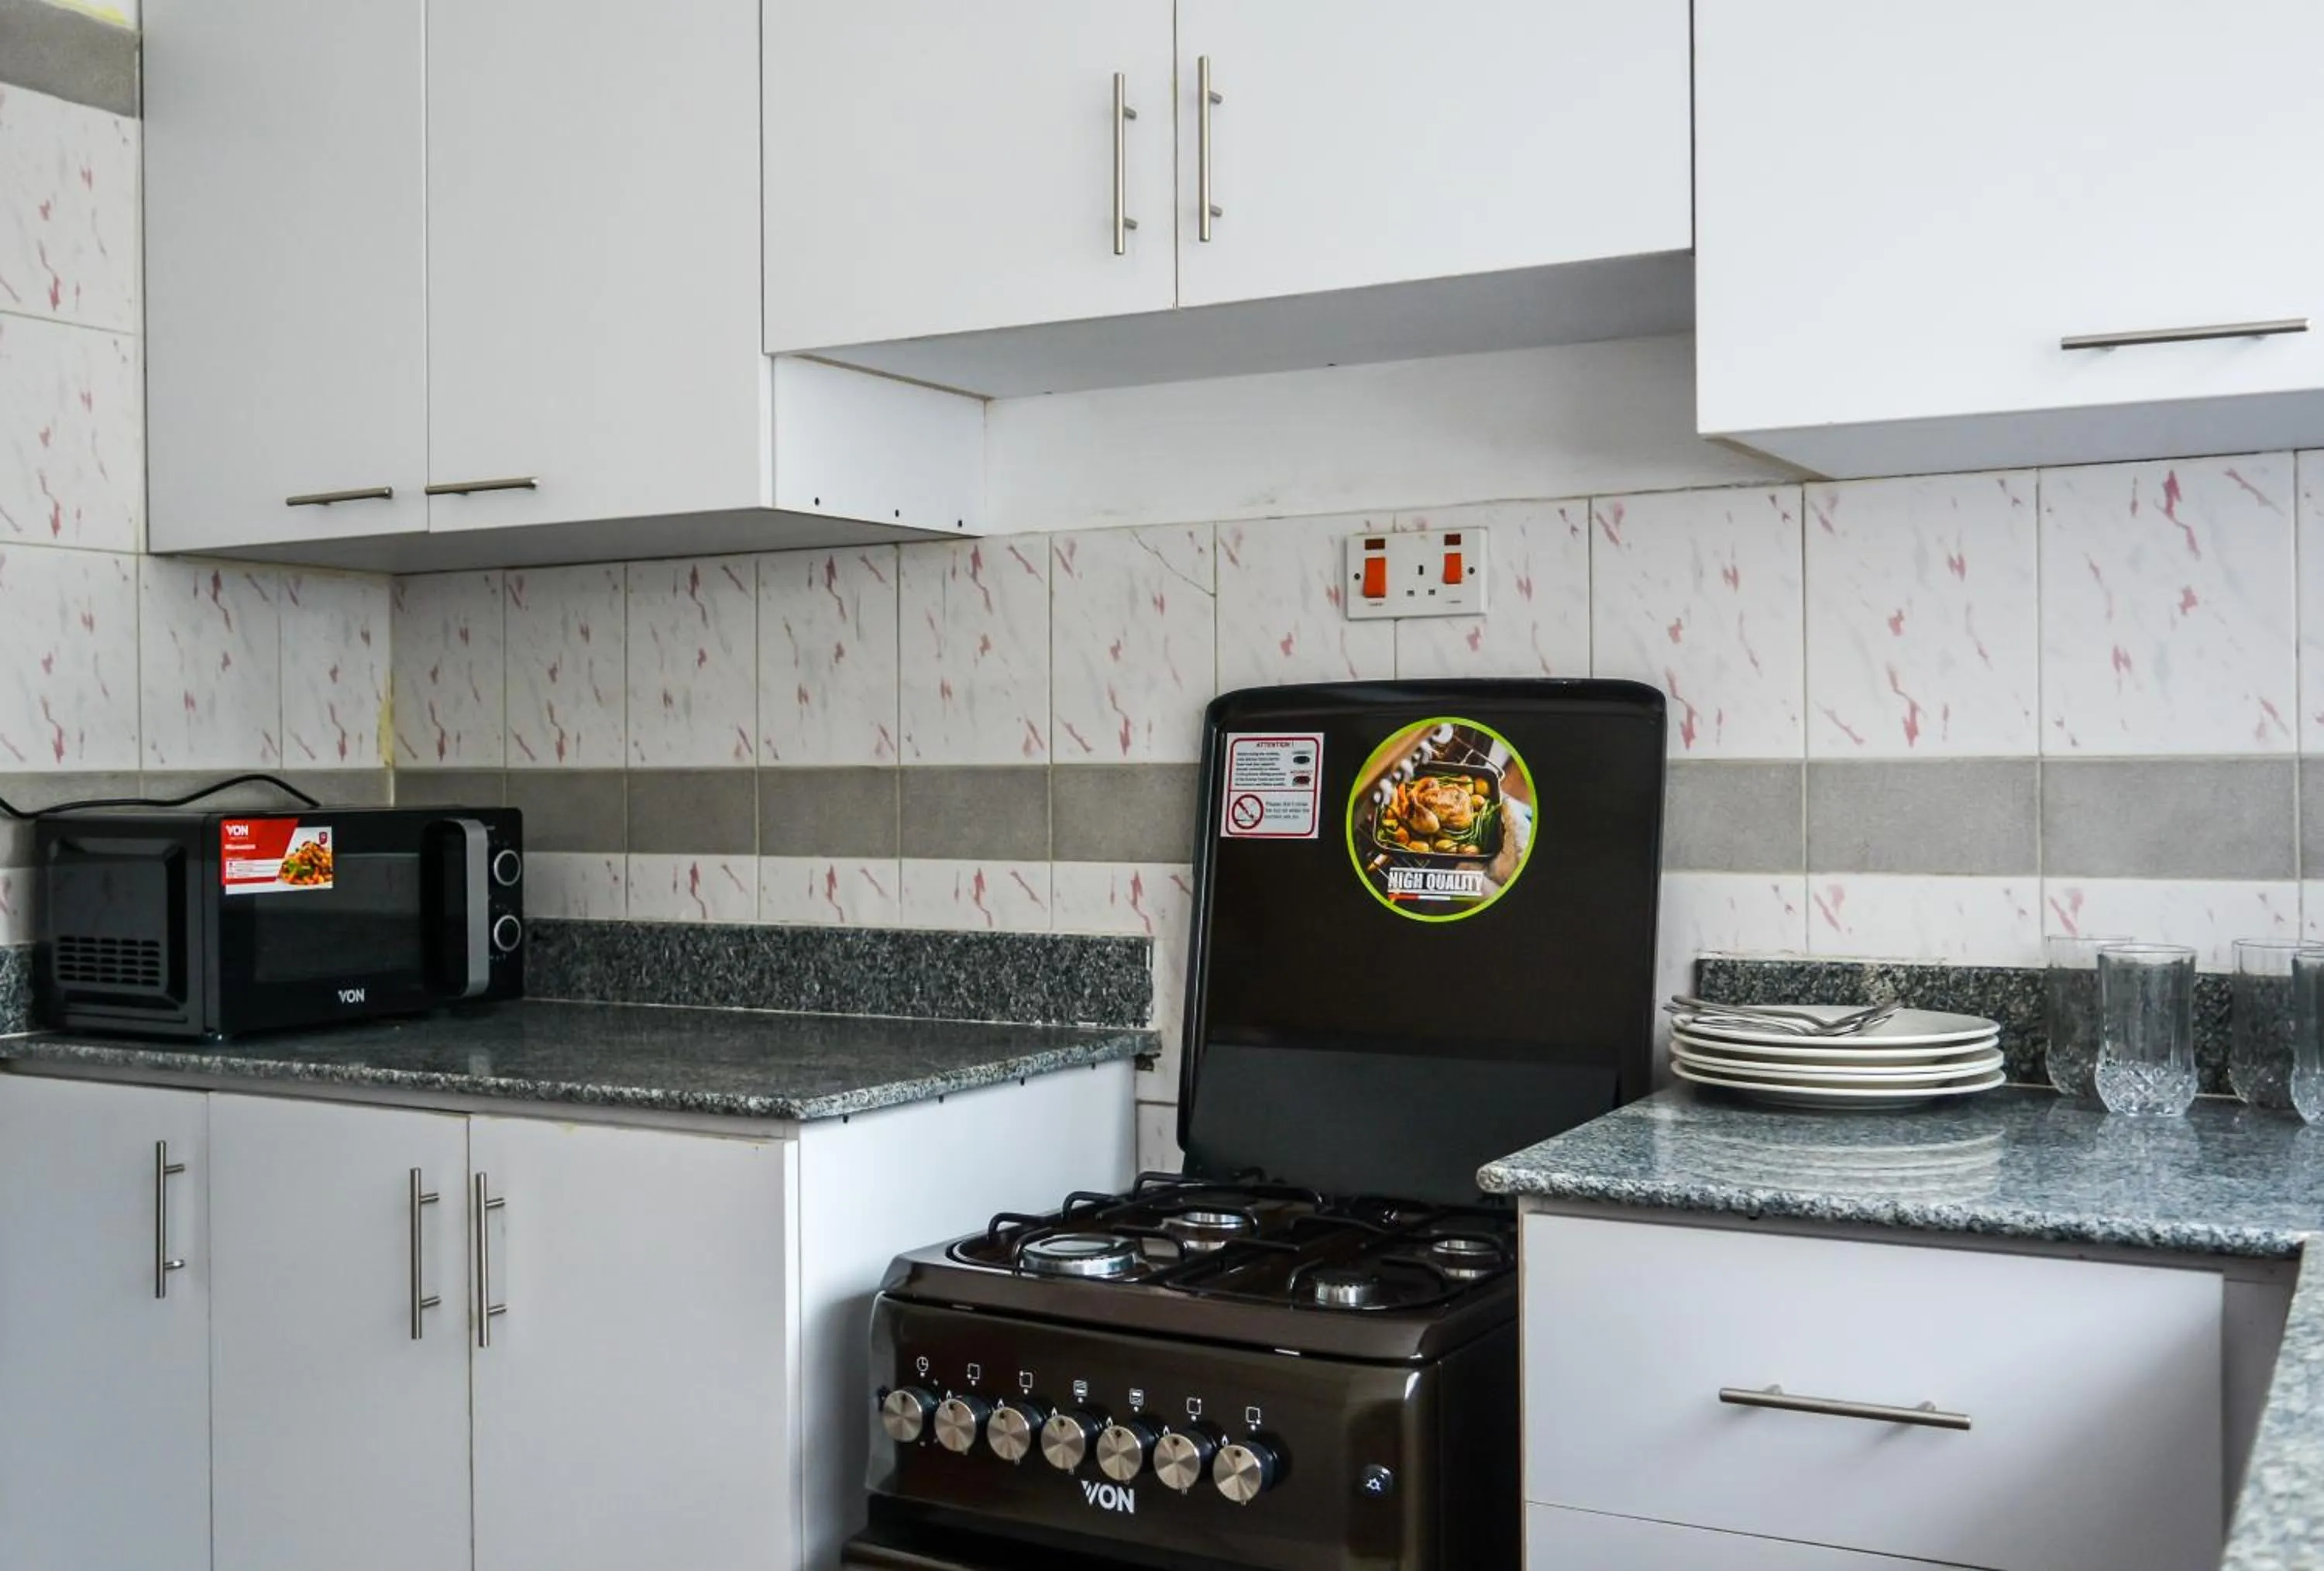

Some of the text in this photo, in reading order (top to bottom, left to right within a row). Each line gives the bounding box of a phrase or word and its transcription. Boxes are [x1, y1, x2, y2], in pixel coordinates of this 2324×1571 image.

[225, 824, 249, 836] VON
[1387, 871, 1483, 891] HIGH QUALITY
[338, 988, 365, 1005] VON
[1081, 1480, 1135, 1514] VON
